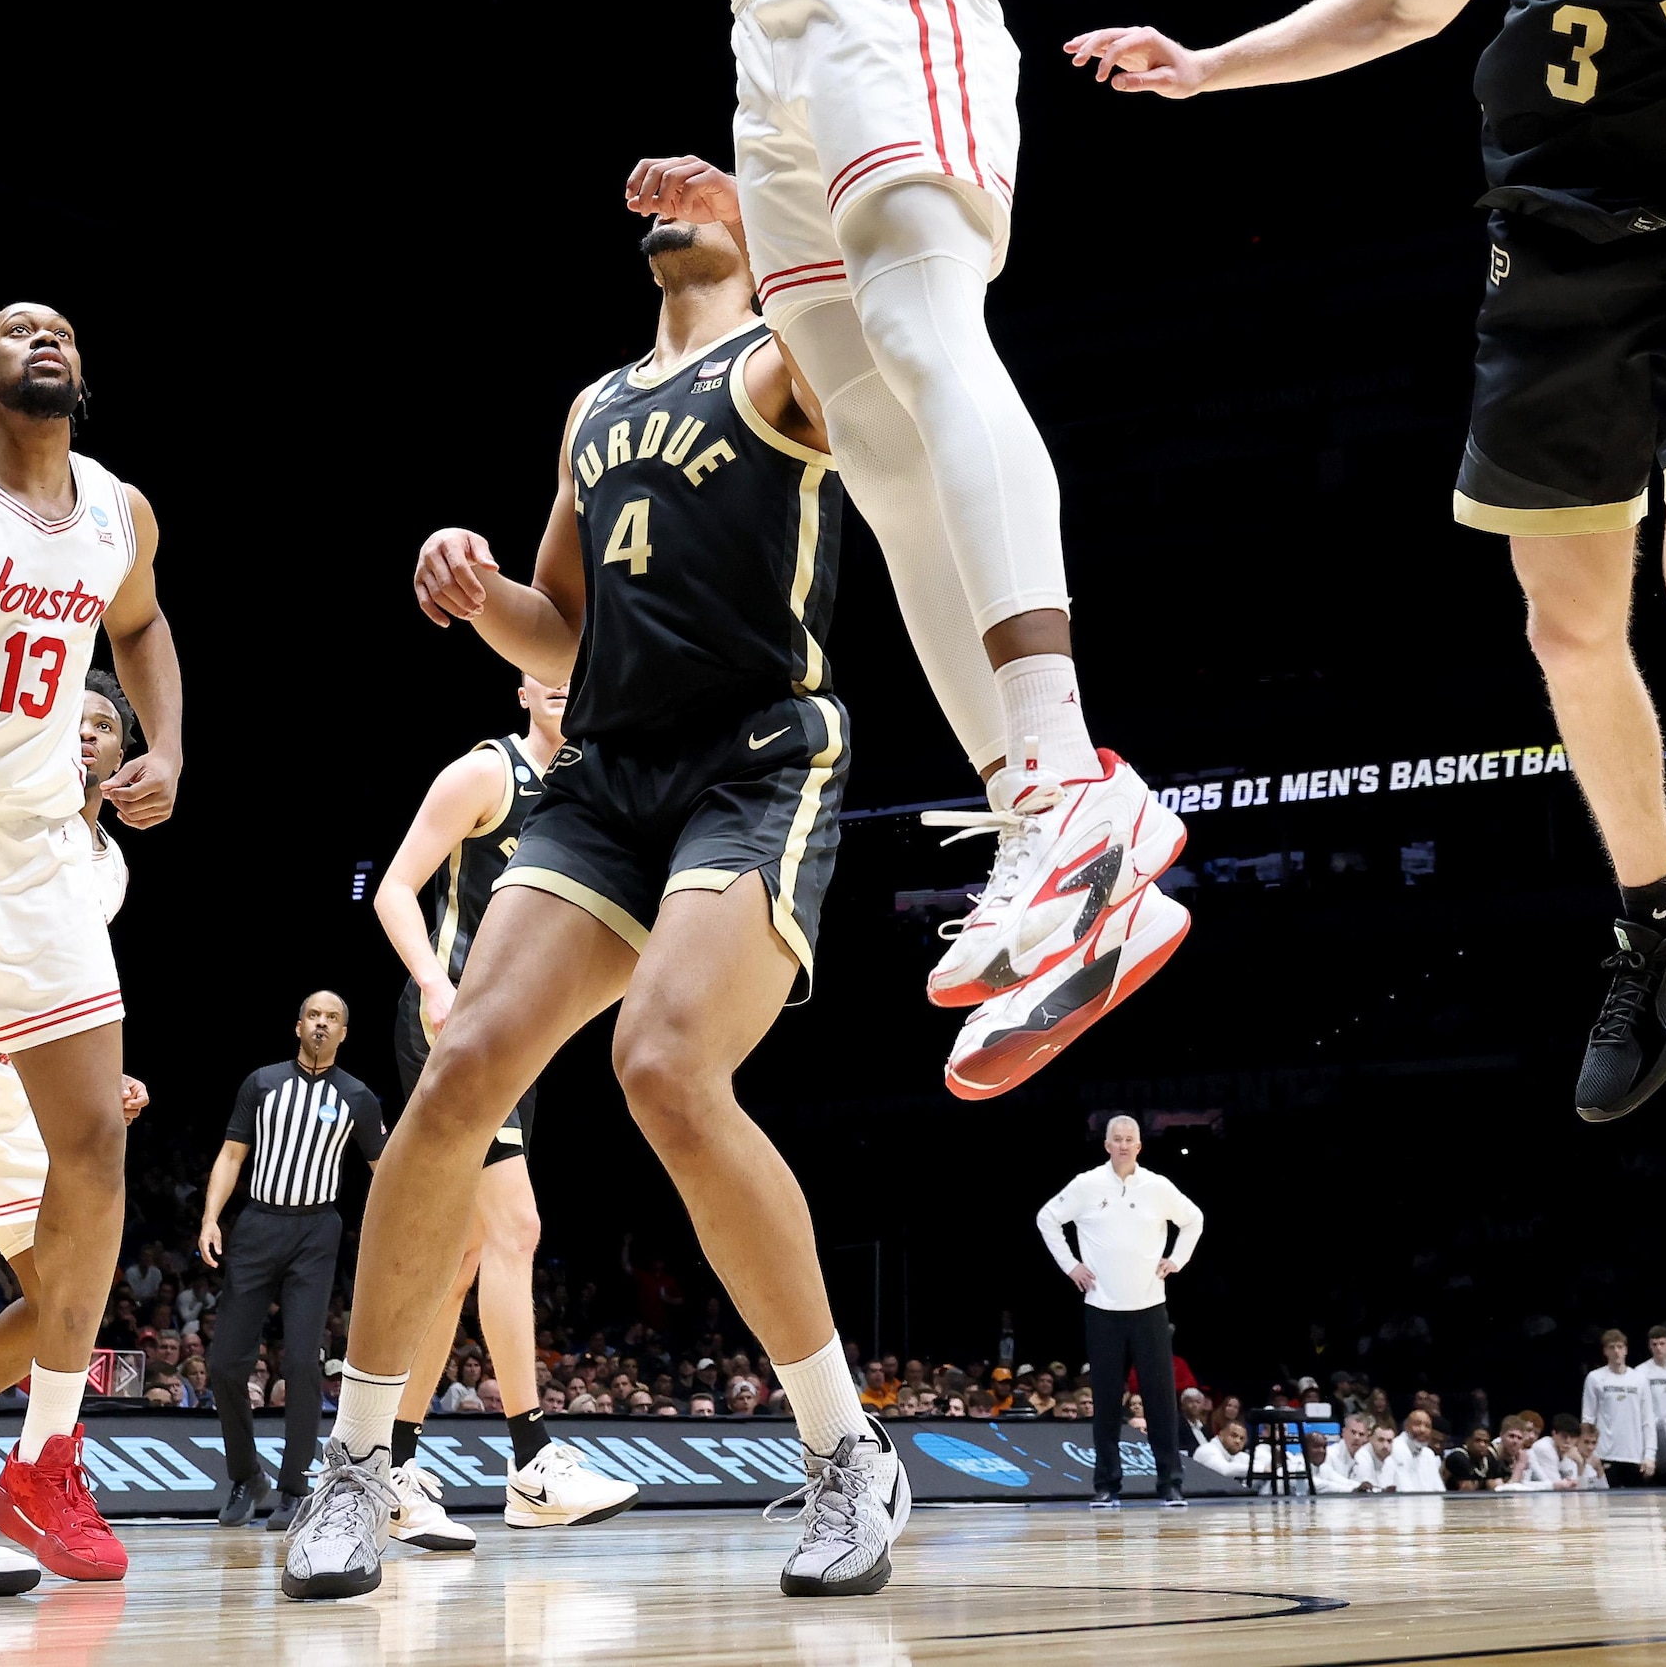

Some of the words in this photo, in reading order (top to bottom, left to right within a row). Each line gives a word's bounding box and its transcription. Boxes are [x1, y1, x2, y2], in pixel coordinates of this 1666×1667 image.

[1545, 4, 1609, 105] 3
[602, 498, 654, 576] 4
[1231, 777, 1271, 807] DI
[1279, 764, 1380, 803] MEN'S
[1389, 743, 1573, 791] BASKETBA
